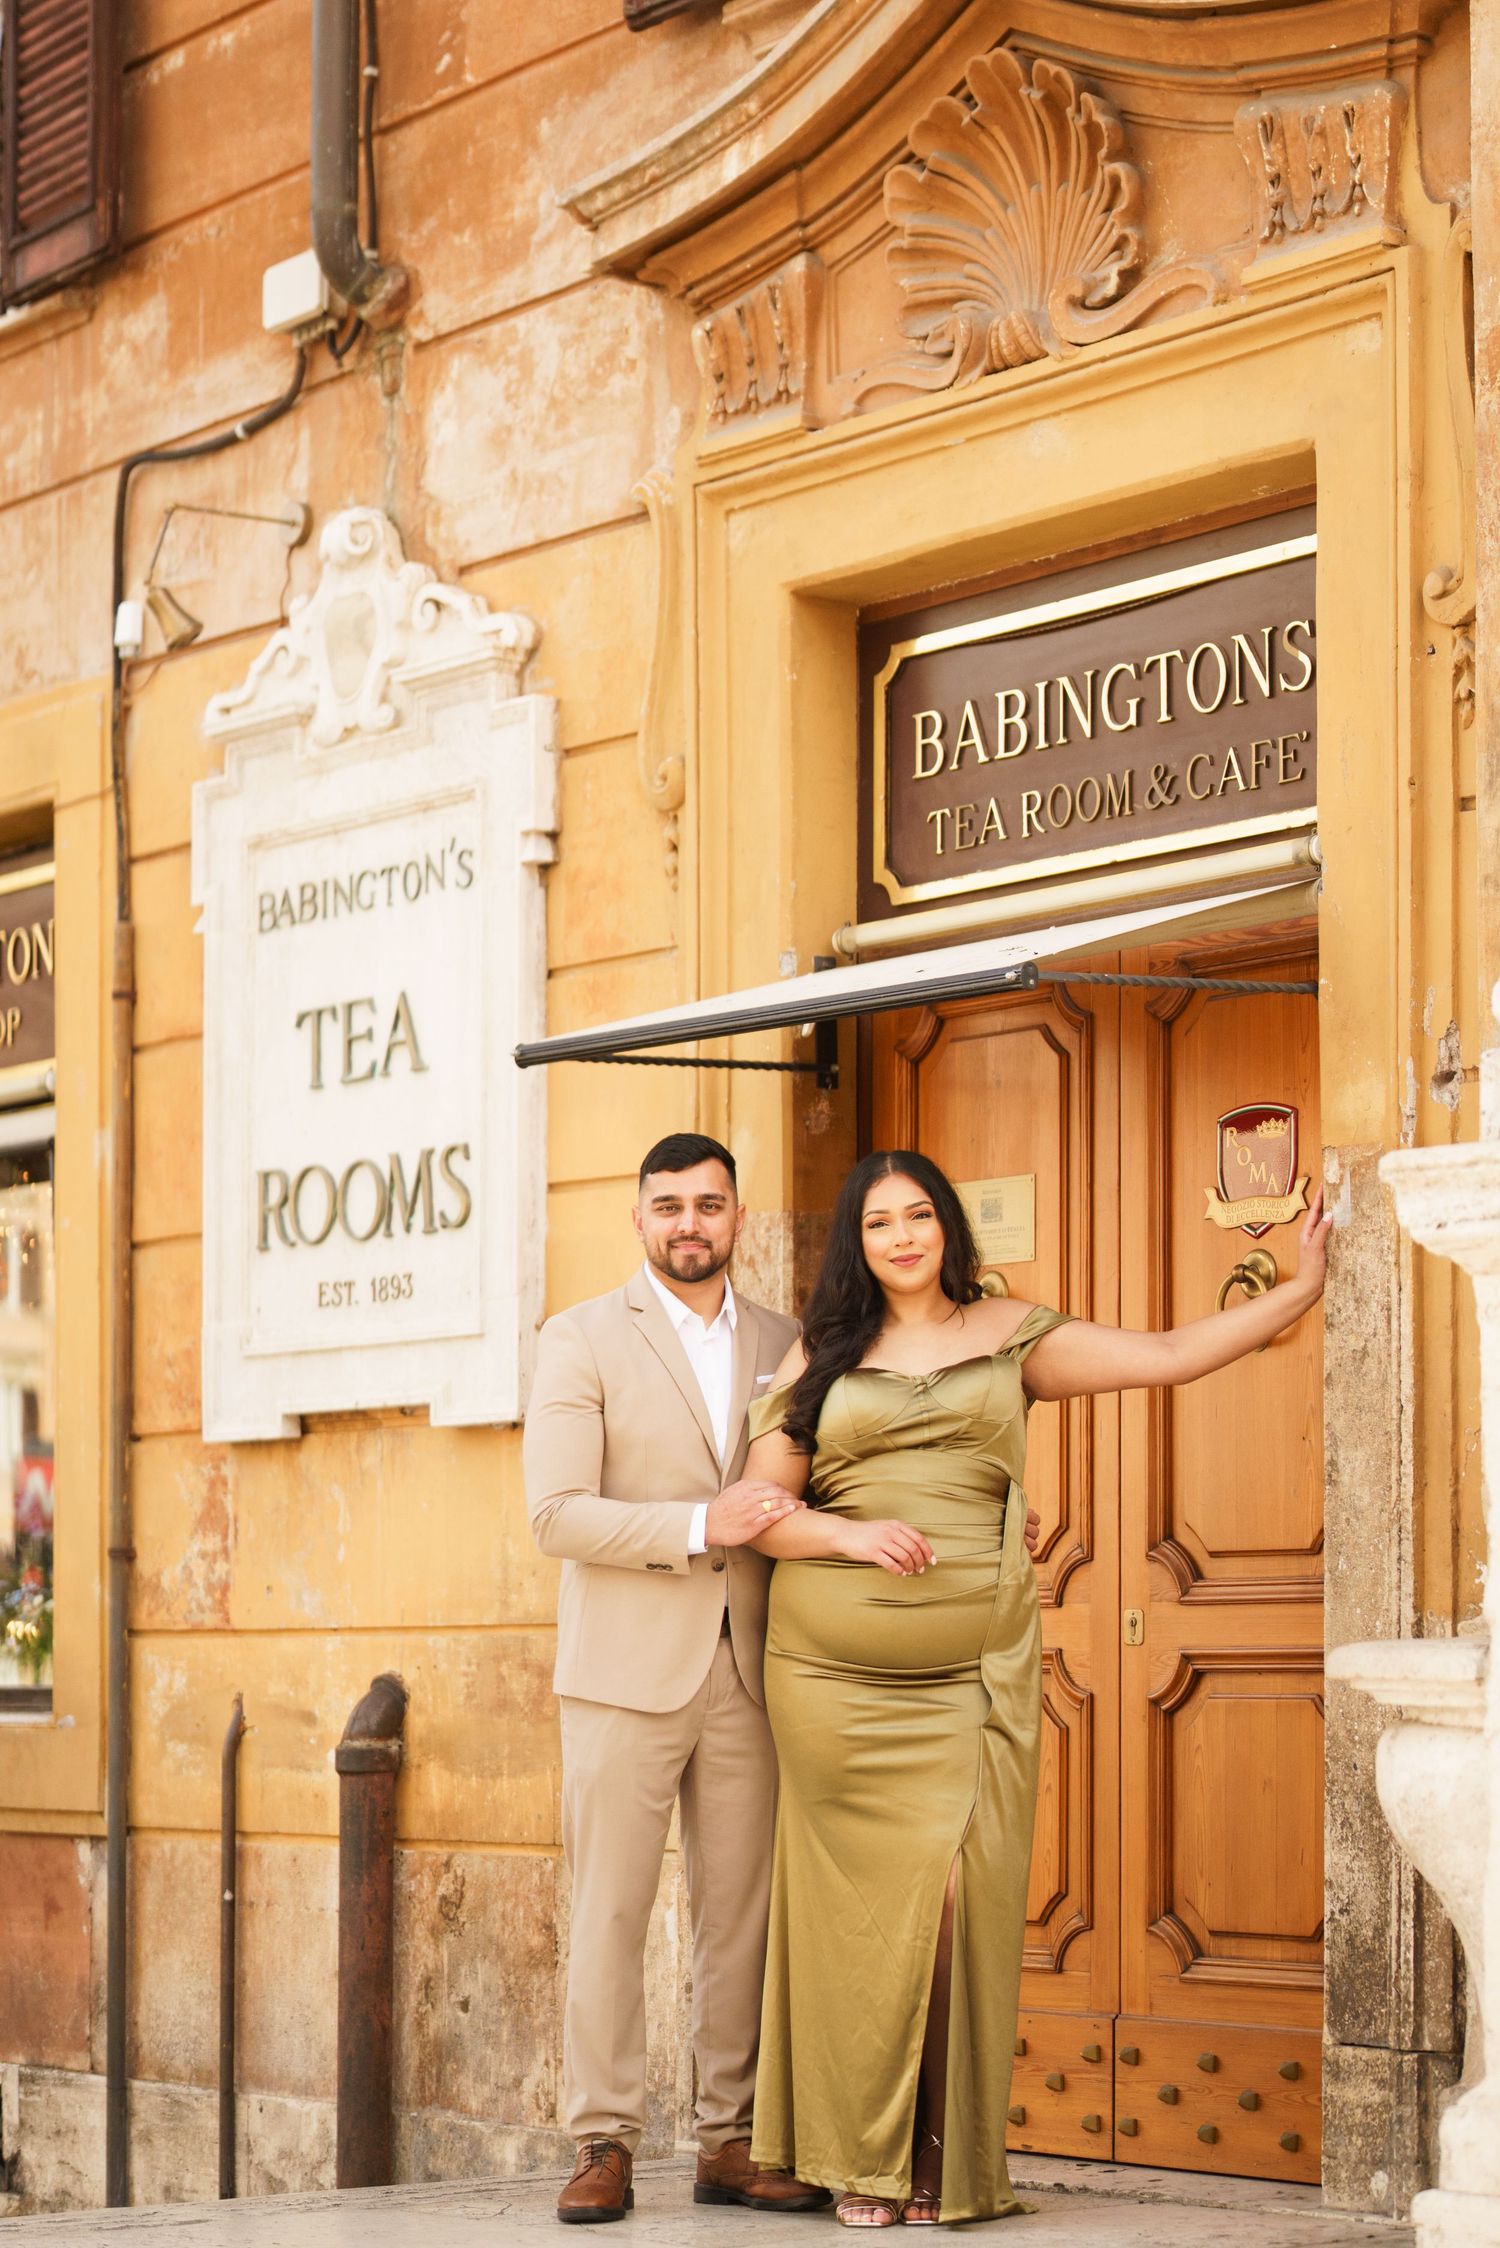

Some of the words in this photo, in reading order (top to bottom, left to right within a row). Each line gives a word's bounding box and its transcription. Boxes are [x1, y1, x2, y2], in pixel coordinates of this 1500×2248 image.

[912, 620, 1313, 780] BABINGTONS
[926, 796, 1008, 856] TEA
[1021, 769, 1133, 839] ROOM
[1143, 762, 1179, 810] &
[257, 837, 476, 935] BABINGTON'S
[0, 918, 54, 985] ON
[295, 990, 429, 1091] TEA
[256, 1143, 472, 1252] ROOMS
[317, 1280, 359, 1308] EST.
[370, 1273, 414, 1303] 1893
